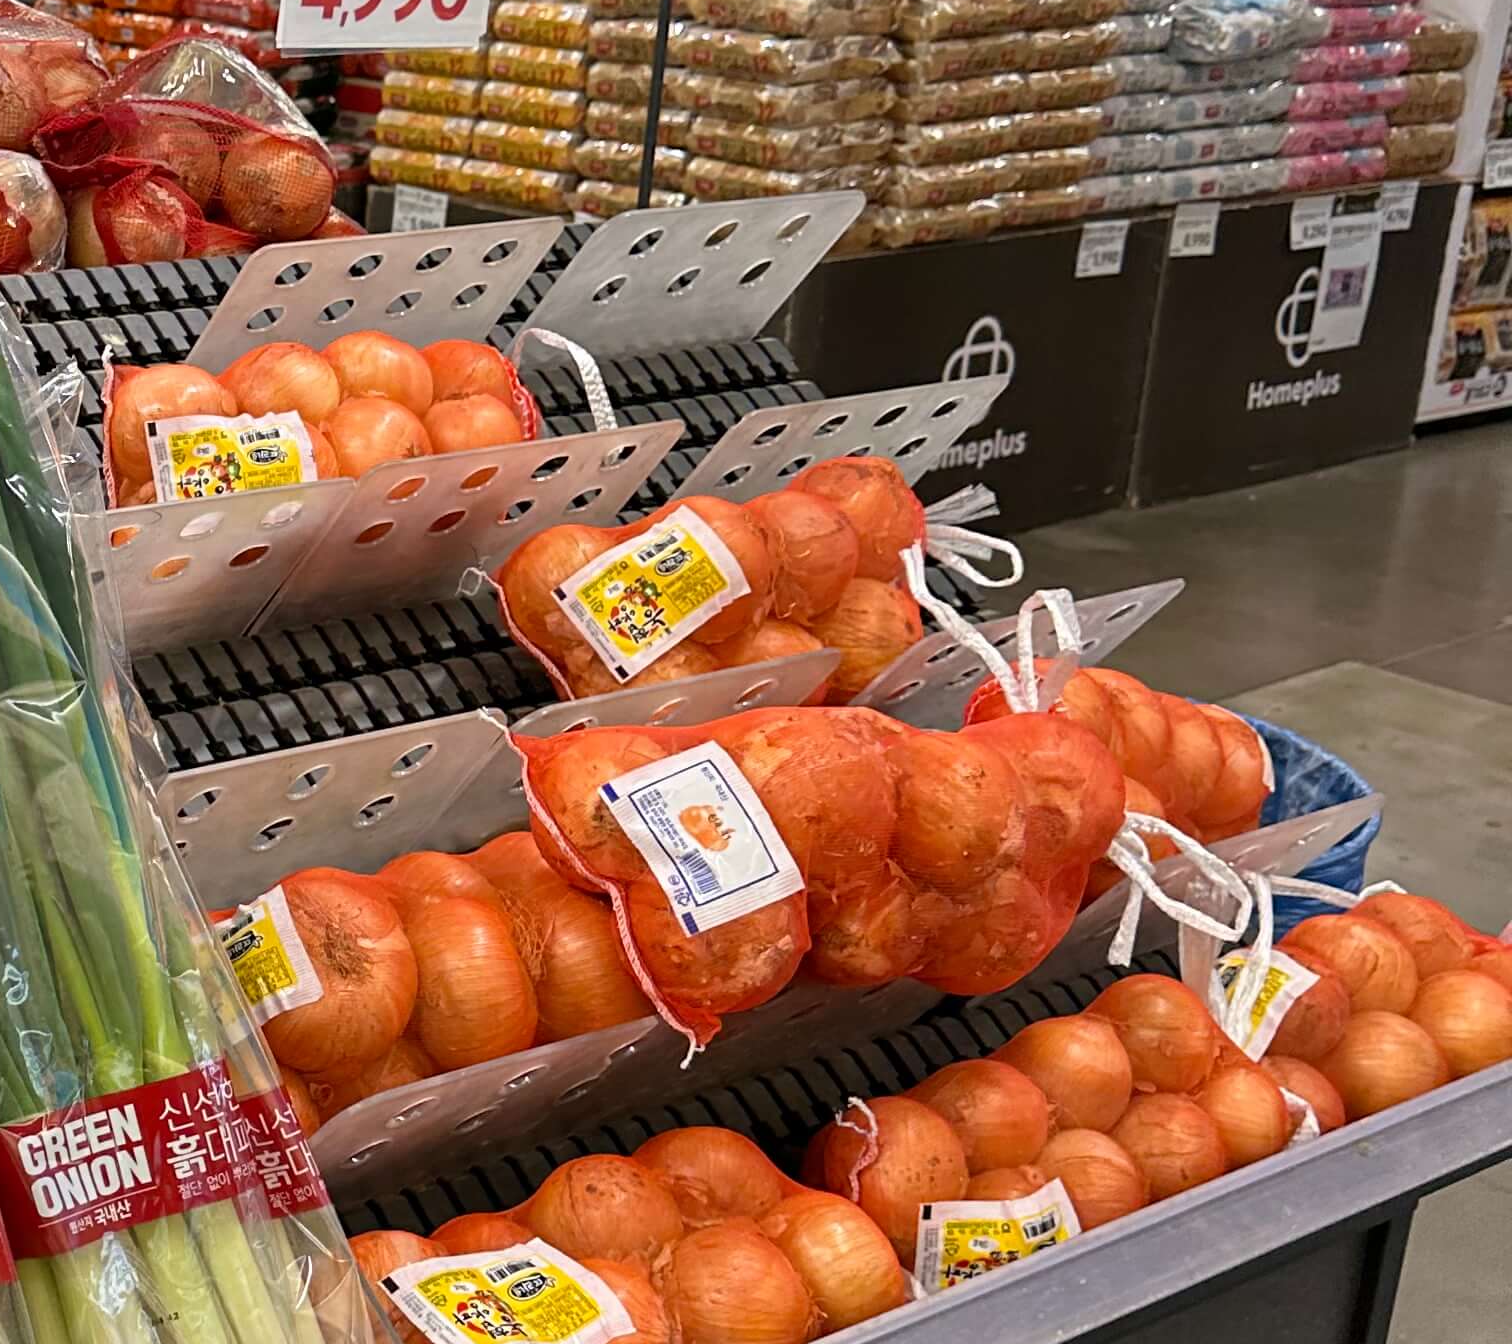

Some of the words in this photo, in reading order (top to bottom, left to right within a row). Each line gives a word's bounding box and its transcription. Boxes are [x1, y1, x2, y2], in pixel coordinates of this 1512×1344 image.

[1246, 369, 1342, 412] Homeplus
[928, 428, 1028, 471] meplus
[18, 1104, 143, 1177] GREEN
[31, 1146, 153, 1219] ONION
[177, 1181, 203, 1200] 절단
[206, 1173, 231, 1192] 없이
[94, 1199, 132, 1227] 국내산
